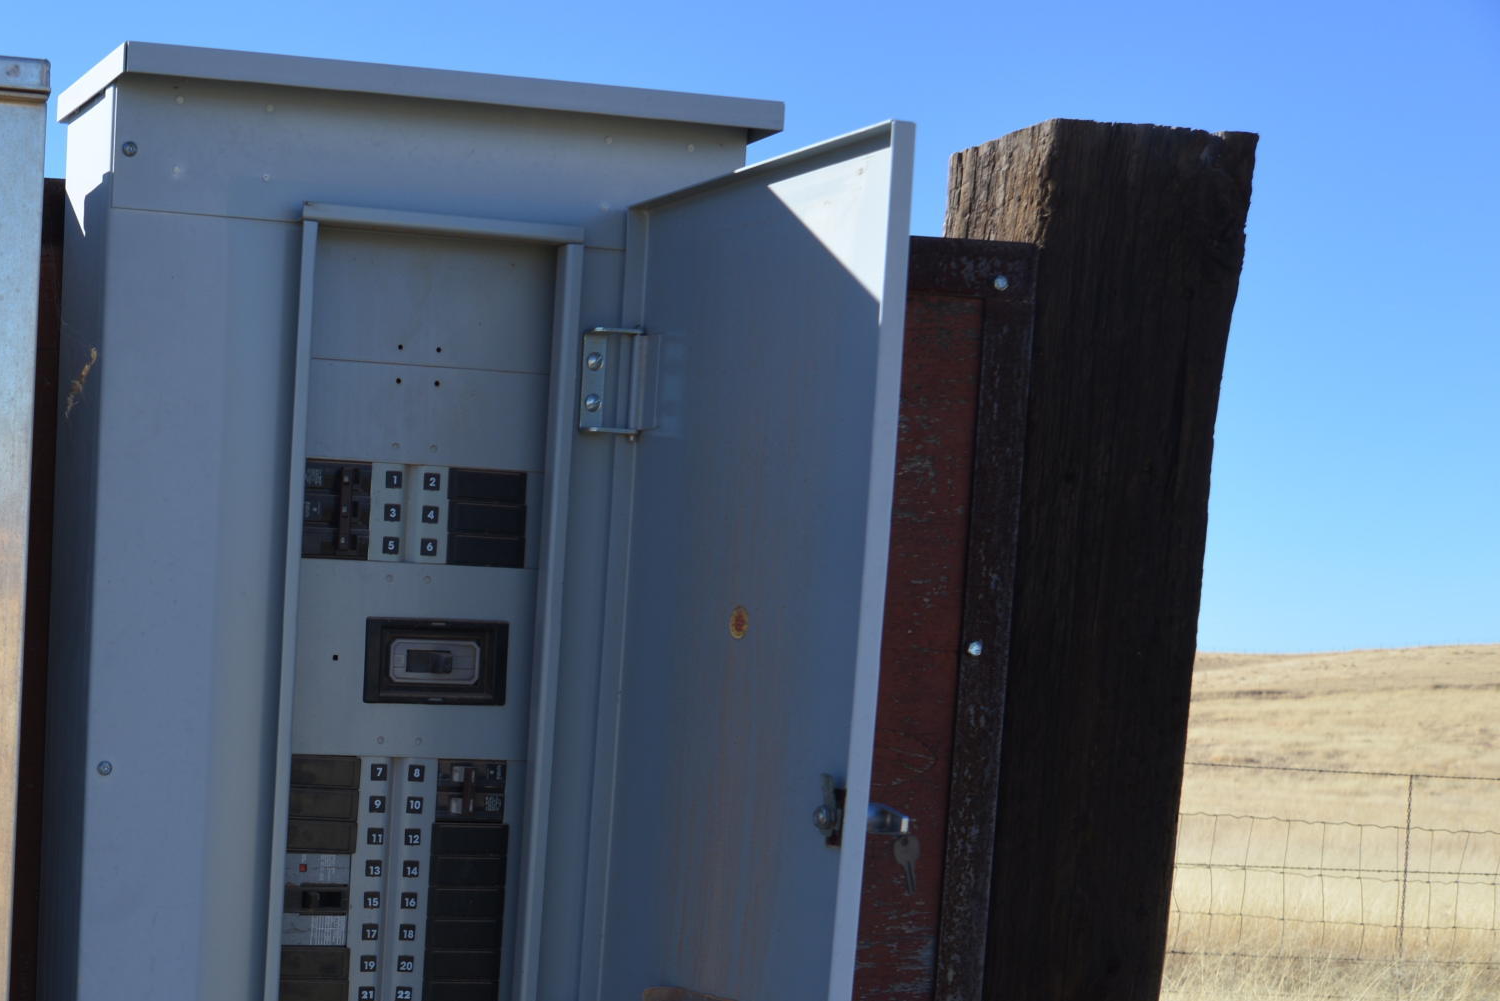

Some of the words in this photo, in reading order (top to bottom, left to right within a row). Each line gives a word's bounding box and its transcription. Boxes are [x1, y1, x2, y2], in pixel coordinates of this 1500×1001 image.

[409, 799, 421, 810] 10
[371, 833, 383, 843] 11
[408, 834, 420, 844] 12
[369, 865, 381, 876] 13
[406, 866, 418, 876] 14
[367, 897, 379, 907] 15
[404, 897, 416, 908] 16
[365, 929, 377, 939] 17
[403, 929, 414, 939] 18
[363, 960, 376, 970] 19
[399, 960, 413, 971] 20
[361, 990, 374, 1000] 21
[396, 990, 411, 1000] 22
